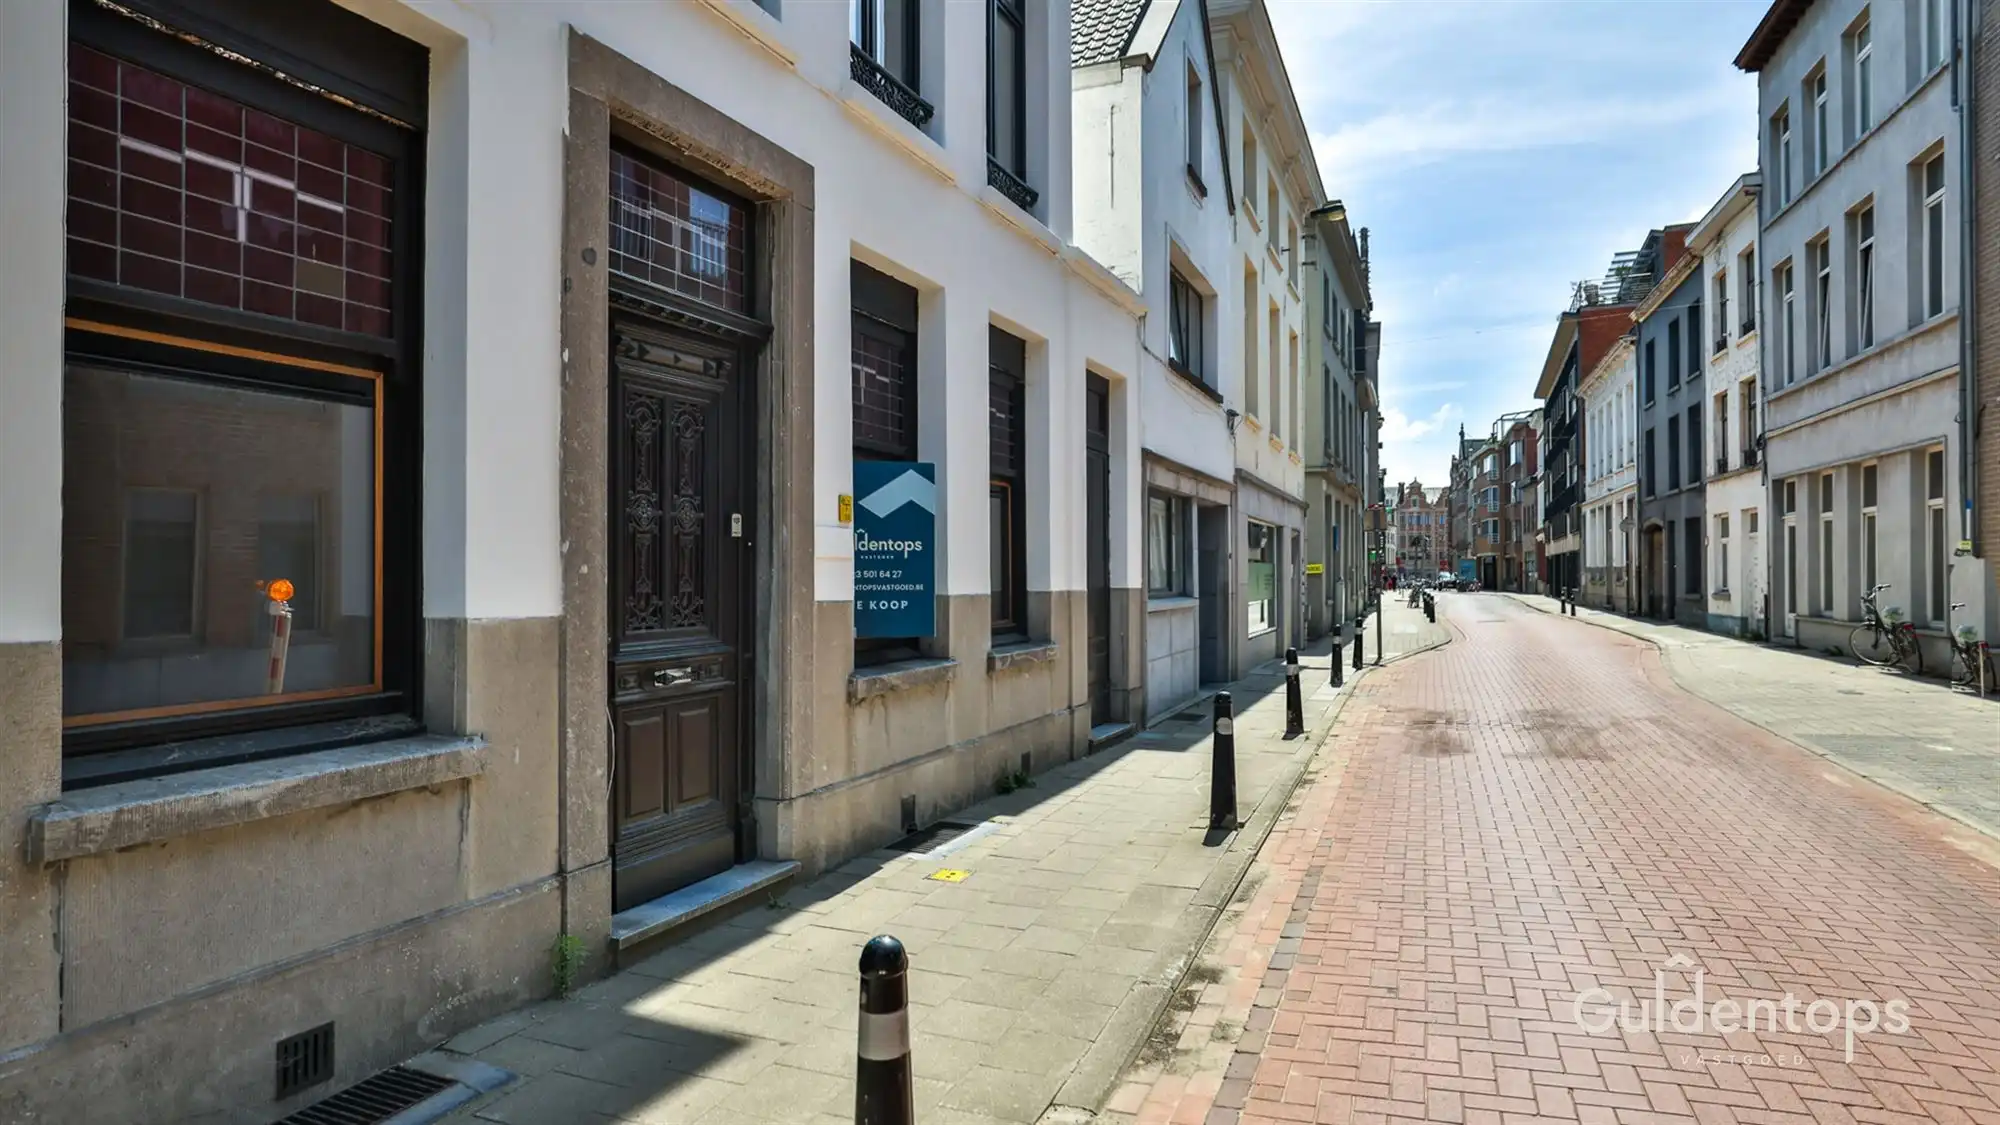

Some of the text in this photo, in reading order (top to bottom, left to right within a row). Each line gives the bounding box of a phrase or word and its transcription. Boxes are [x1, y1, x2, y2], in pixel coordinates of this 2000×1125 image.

[863, 570, 877, 578] 501
[879, 570, 890, 578] 64
[892, 570, 902, 578] 27
[869, 600, 909, 610] KOOP
